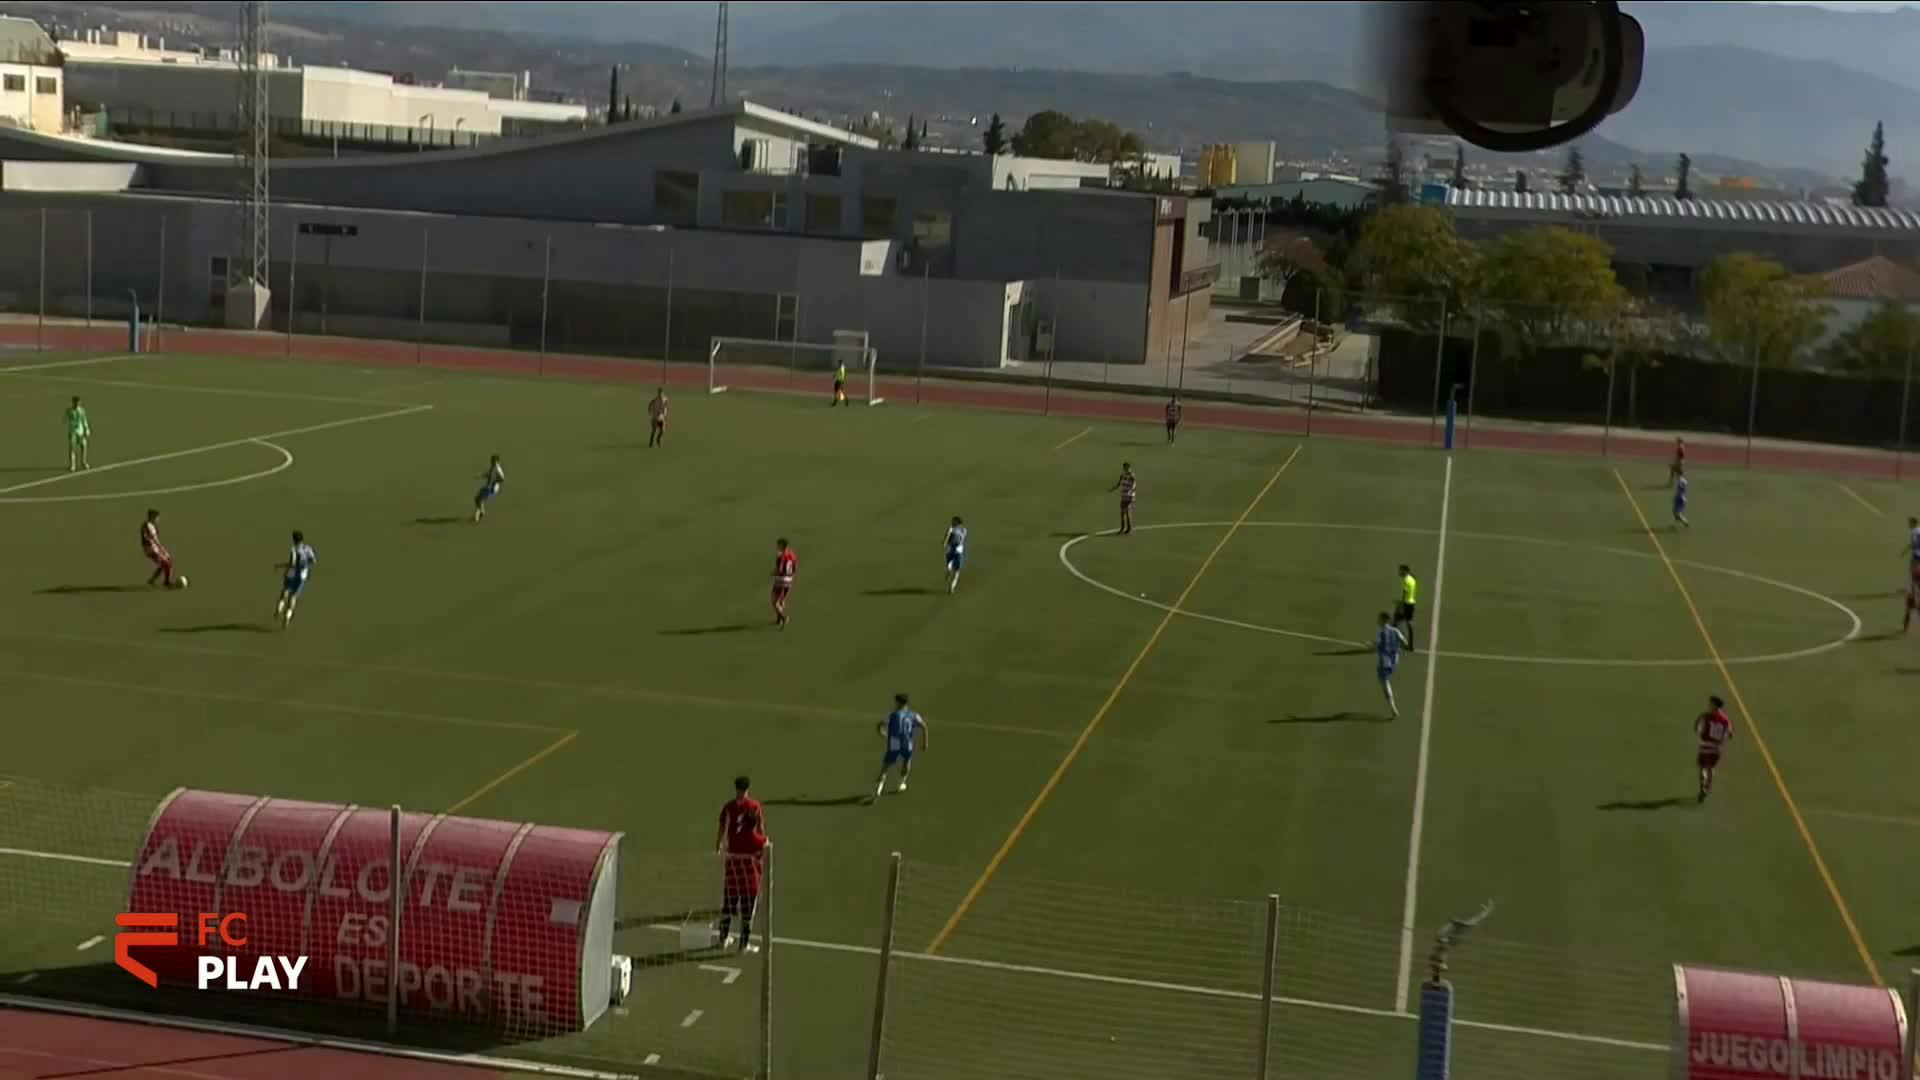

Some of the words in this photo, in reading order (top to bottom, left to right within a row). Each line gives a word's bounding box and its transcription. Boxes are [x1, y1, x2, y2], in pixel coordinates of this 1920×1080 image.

[139, 836, 493, 912] ALBOLOTE
[337, 911, 389, 947] ES
[334, 955, 544, 1020] DEPORTE
[1693, 1032, 1790, 1073] JUEGO
[1797, 1041, 1897, 1080] LIMPIO
